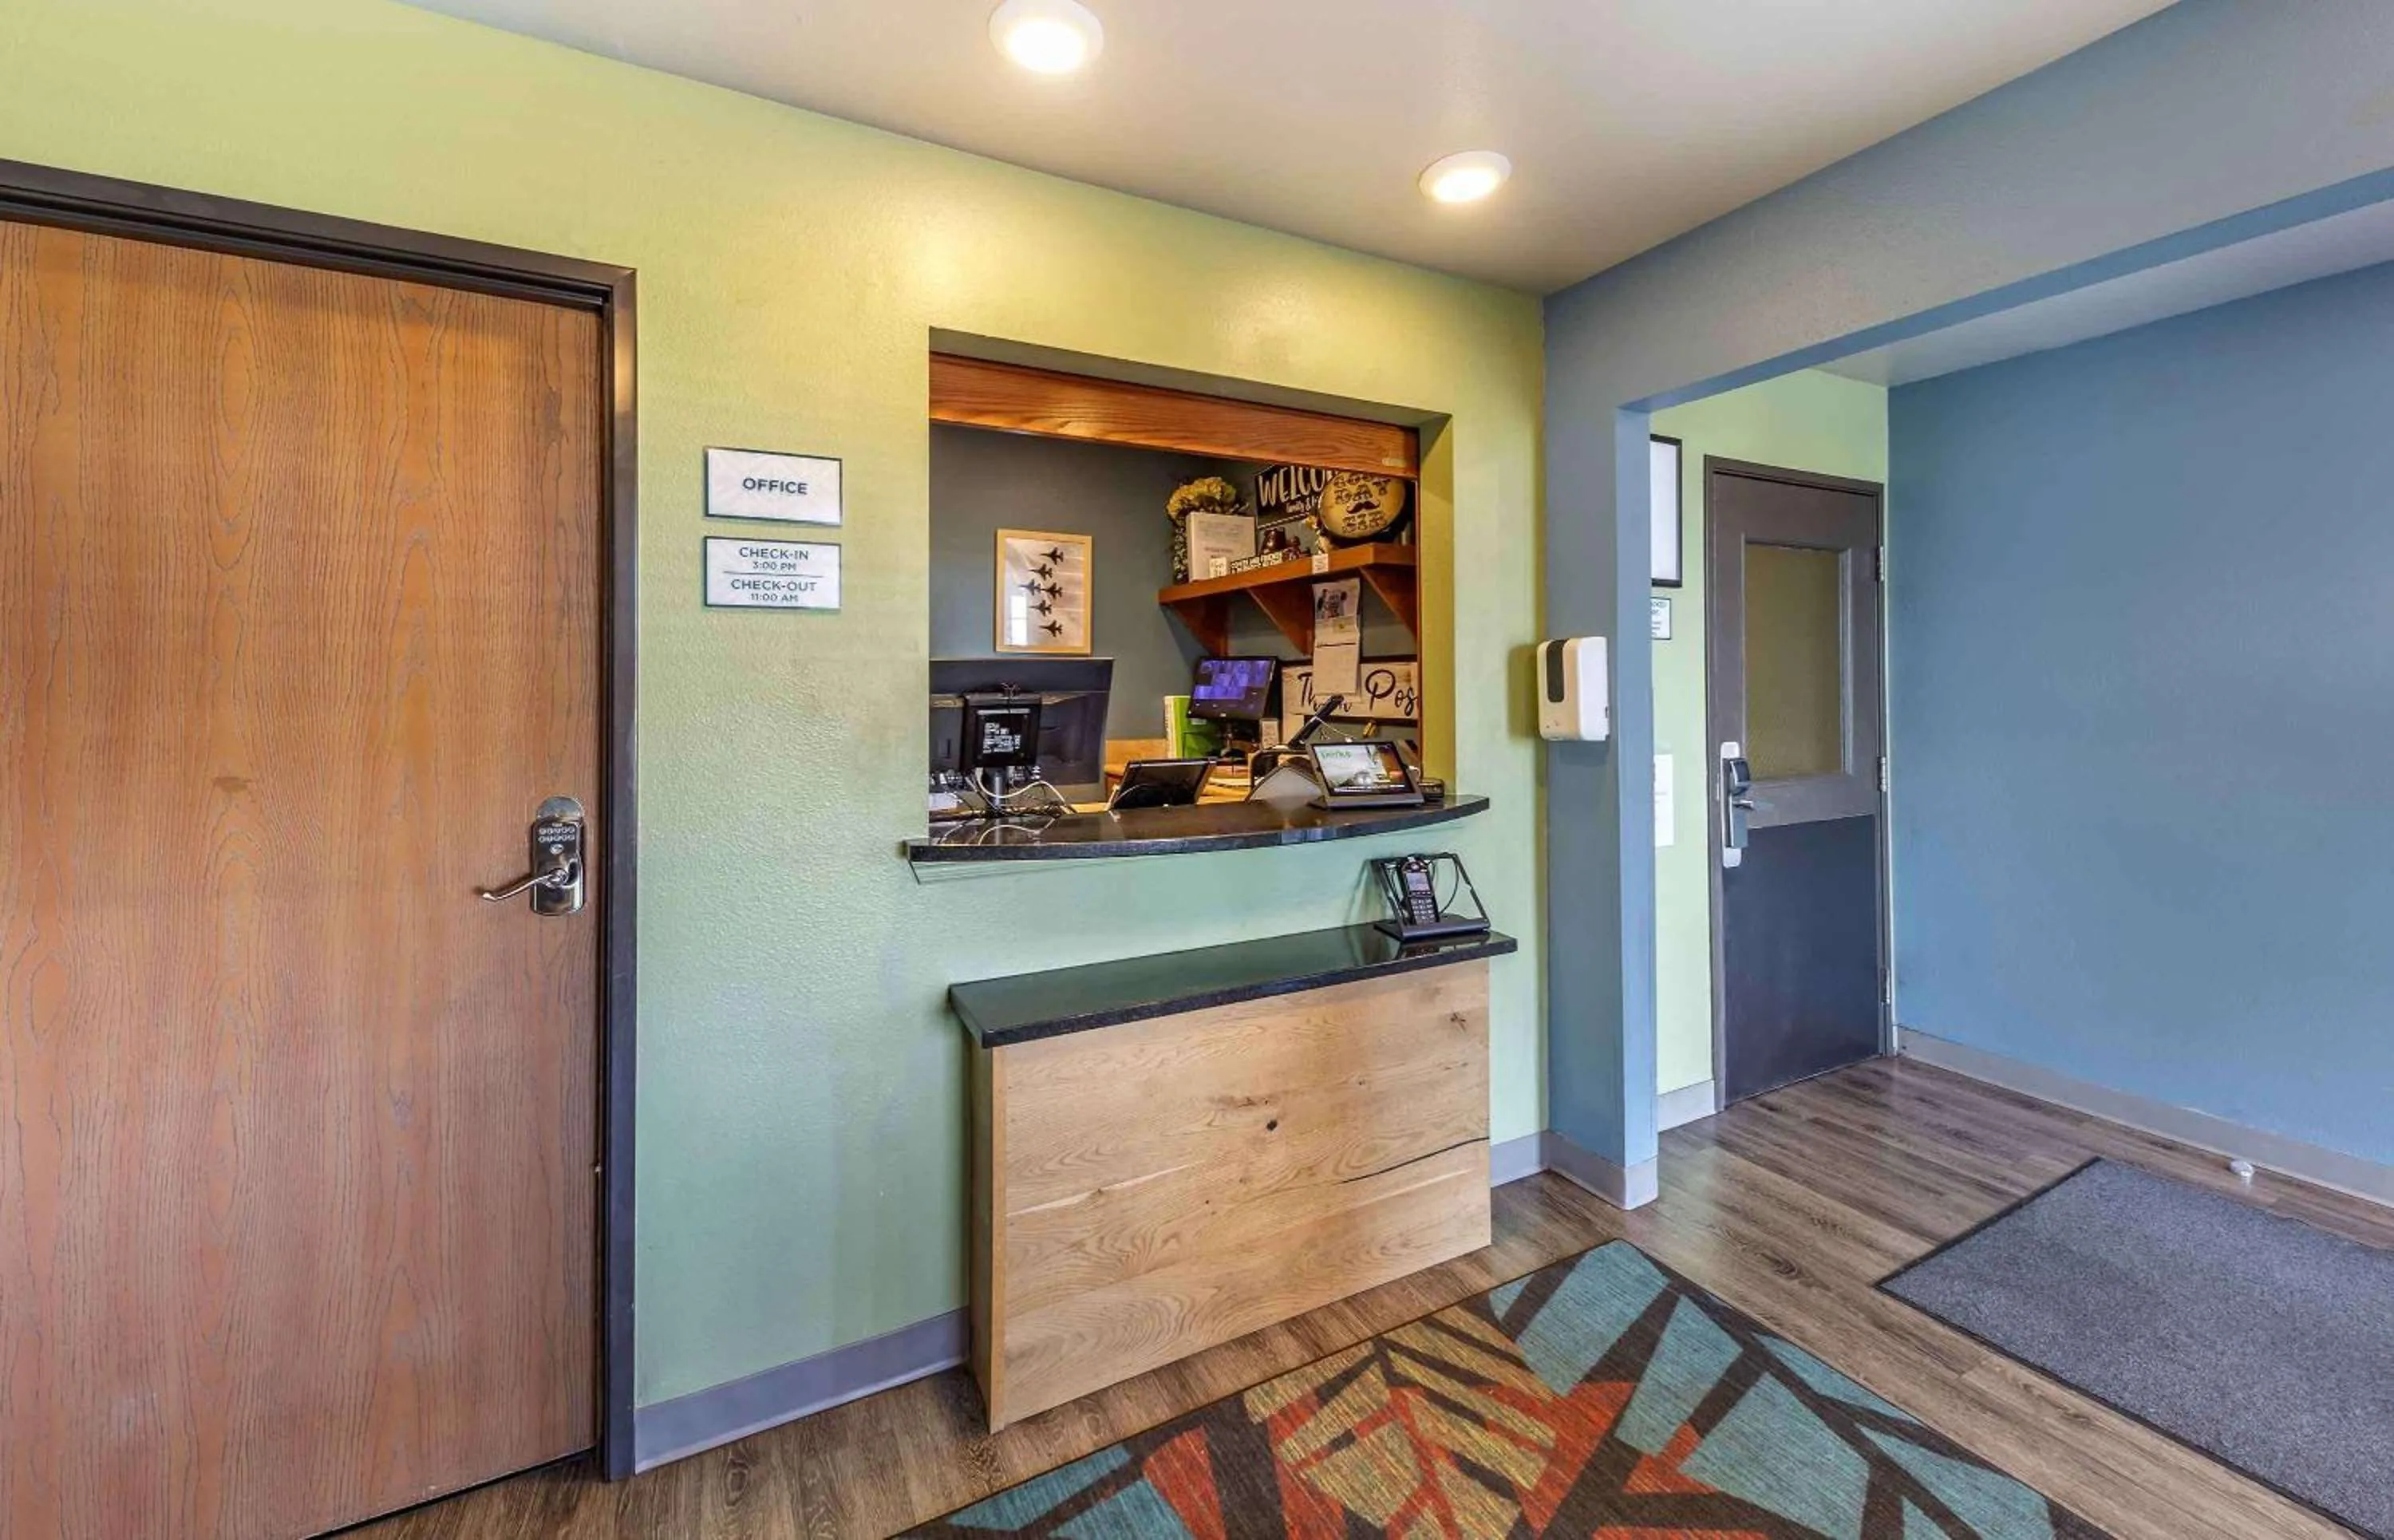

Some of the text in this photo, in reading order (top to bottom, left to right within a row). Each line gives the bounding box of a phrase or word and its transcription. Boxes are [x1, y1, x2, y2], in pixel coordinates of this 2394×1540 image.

[742, 477, 808, 496] OFFICE
[739, 547, 809, 560] CHECK-IN
[753, 561, 797, 571] 3:00 PM
[730, 578, 817, 592] CHECK-OUT
[750, 593, 799, 602] 11:00 AM
